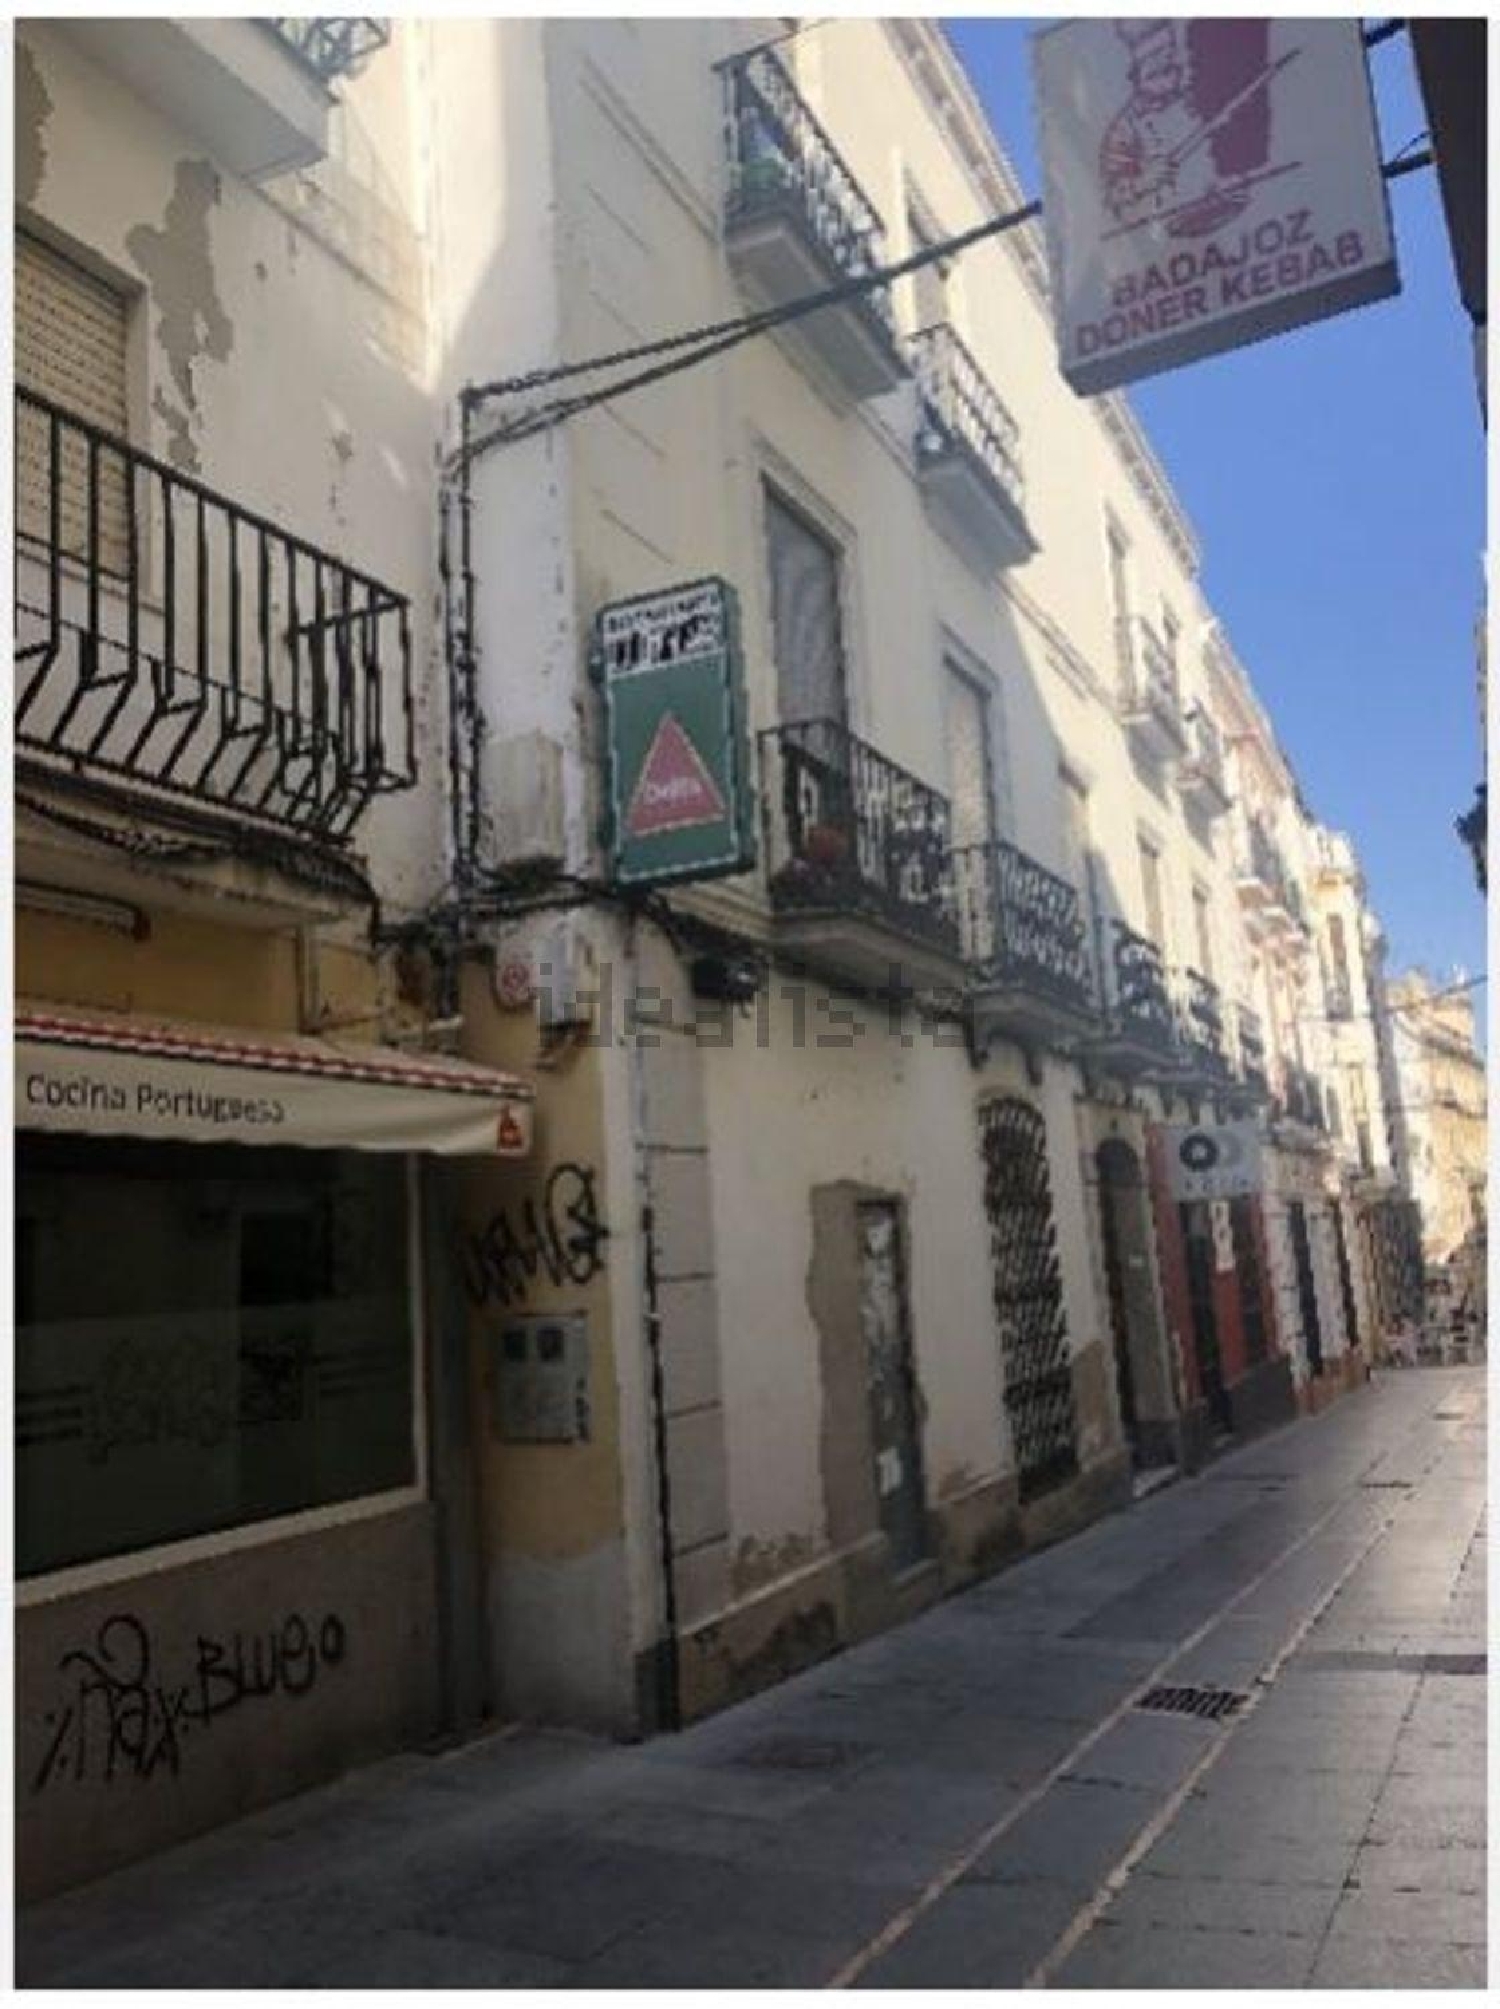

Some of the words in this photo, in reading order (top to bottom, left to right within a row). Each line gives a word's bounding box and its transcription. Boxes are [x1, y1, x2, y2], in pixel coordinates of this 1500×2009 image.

[1075, 287, 1208, 357] DONER
[1220, 228, 1364, 304] KEBAB
[1112, 208, 1314, 307] BADAJOZ
[26, 1072, 127, 1113] Cocina
